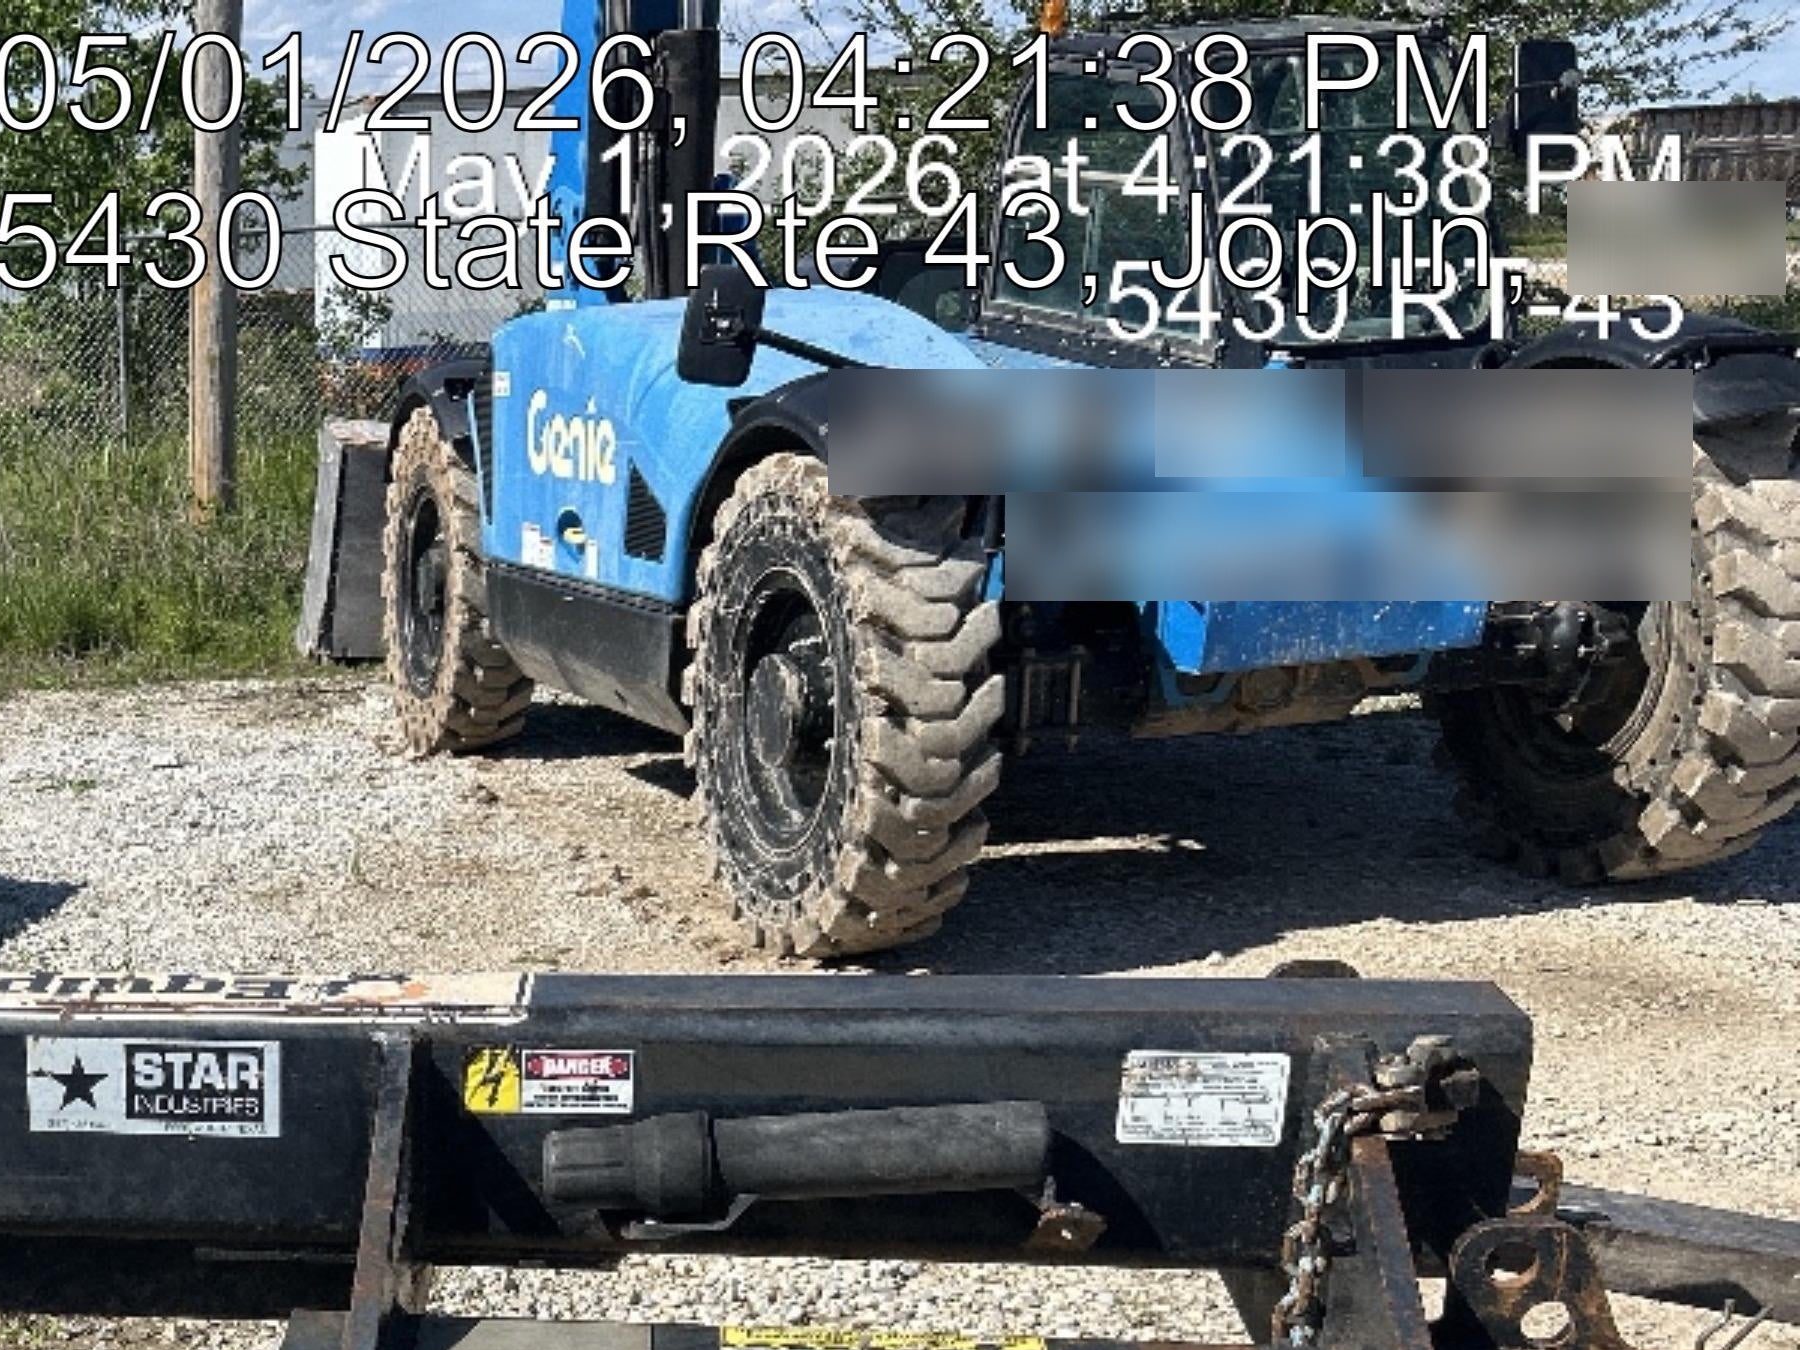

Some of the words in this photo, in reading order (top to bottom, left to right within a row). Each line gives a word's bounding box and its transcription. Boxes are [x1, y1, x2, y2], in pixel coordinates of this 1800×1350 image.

[526, 387, 616, 486] Genie
[132, 1051, 263, 1091] STAR
[540, 1054, 616, 1079] DANGER
[133, 1094, 259, 1117] INDUSTRIES
